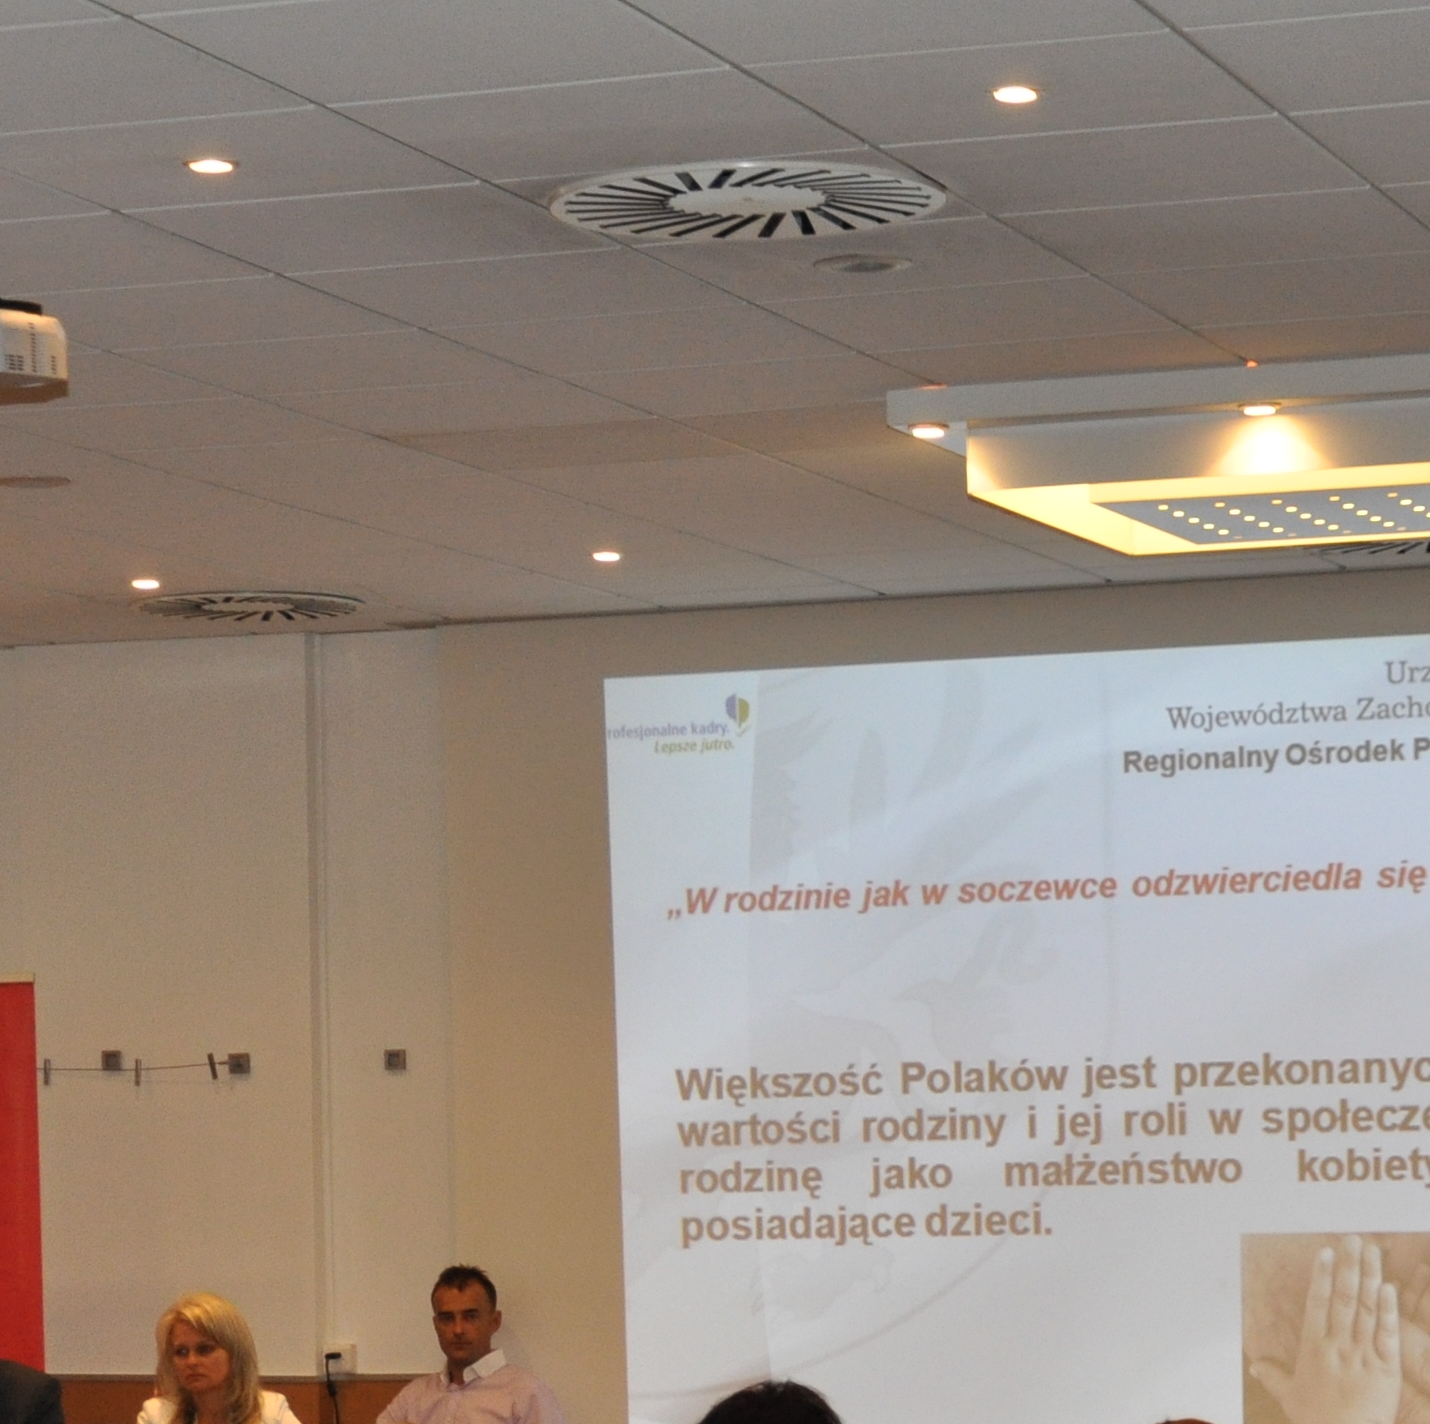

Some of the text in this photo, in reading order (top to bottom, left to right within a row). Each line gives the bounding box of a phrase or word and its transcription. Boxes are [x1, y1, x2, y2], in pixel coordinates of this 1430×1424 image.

[607, 721, 688, 741] rofesjonalne
[1166, 701, 1348, 733] Województwa
[1123, 745, 1280, 778] Regionalny
[1284, 738, 1406, 766] Ośrodek
[722, 881, 852, 914] rodzinie
[858, 879, 912, 915] jak
[920, 883, 949, 906] w
[957, 875, 1119, 905] soczewce
[1131, 862, 1363, 898] odzwierciedla
[1376, 858, 1428, 895] się
[674, 1062, 884, 1108] Większość
[900, 1058, 1070, 1095] Polaków
[1081, 1055, 1158, 1099] jest
[676, 1110, 841, 1148] wartości
[861, 1106, 1007, 1148] rodziny
[1026, 1104, 1038, 1140] i
[1053, 1103, 1104, 1147] jej
[1123, 1101, 1188, 1137] roli
[1207, 1108, 1244, 1135] w
[679, 1160, 824, 1200] rodzinę
[868, 1156, 954, 1199] jako
[1003, 1151, 1243, 1188] małżeństwo
[680, 1201, 1053, 1250] posiadające dzieci.
